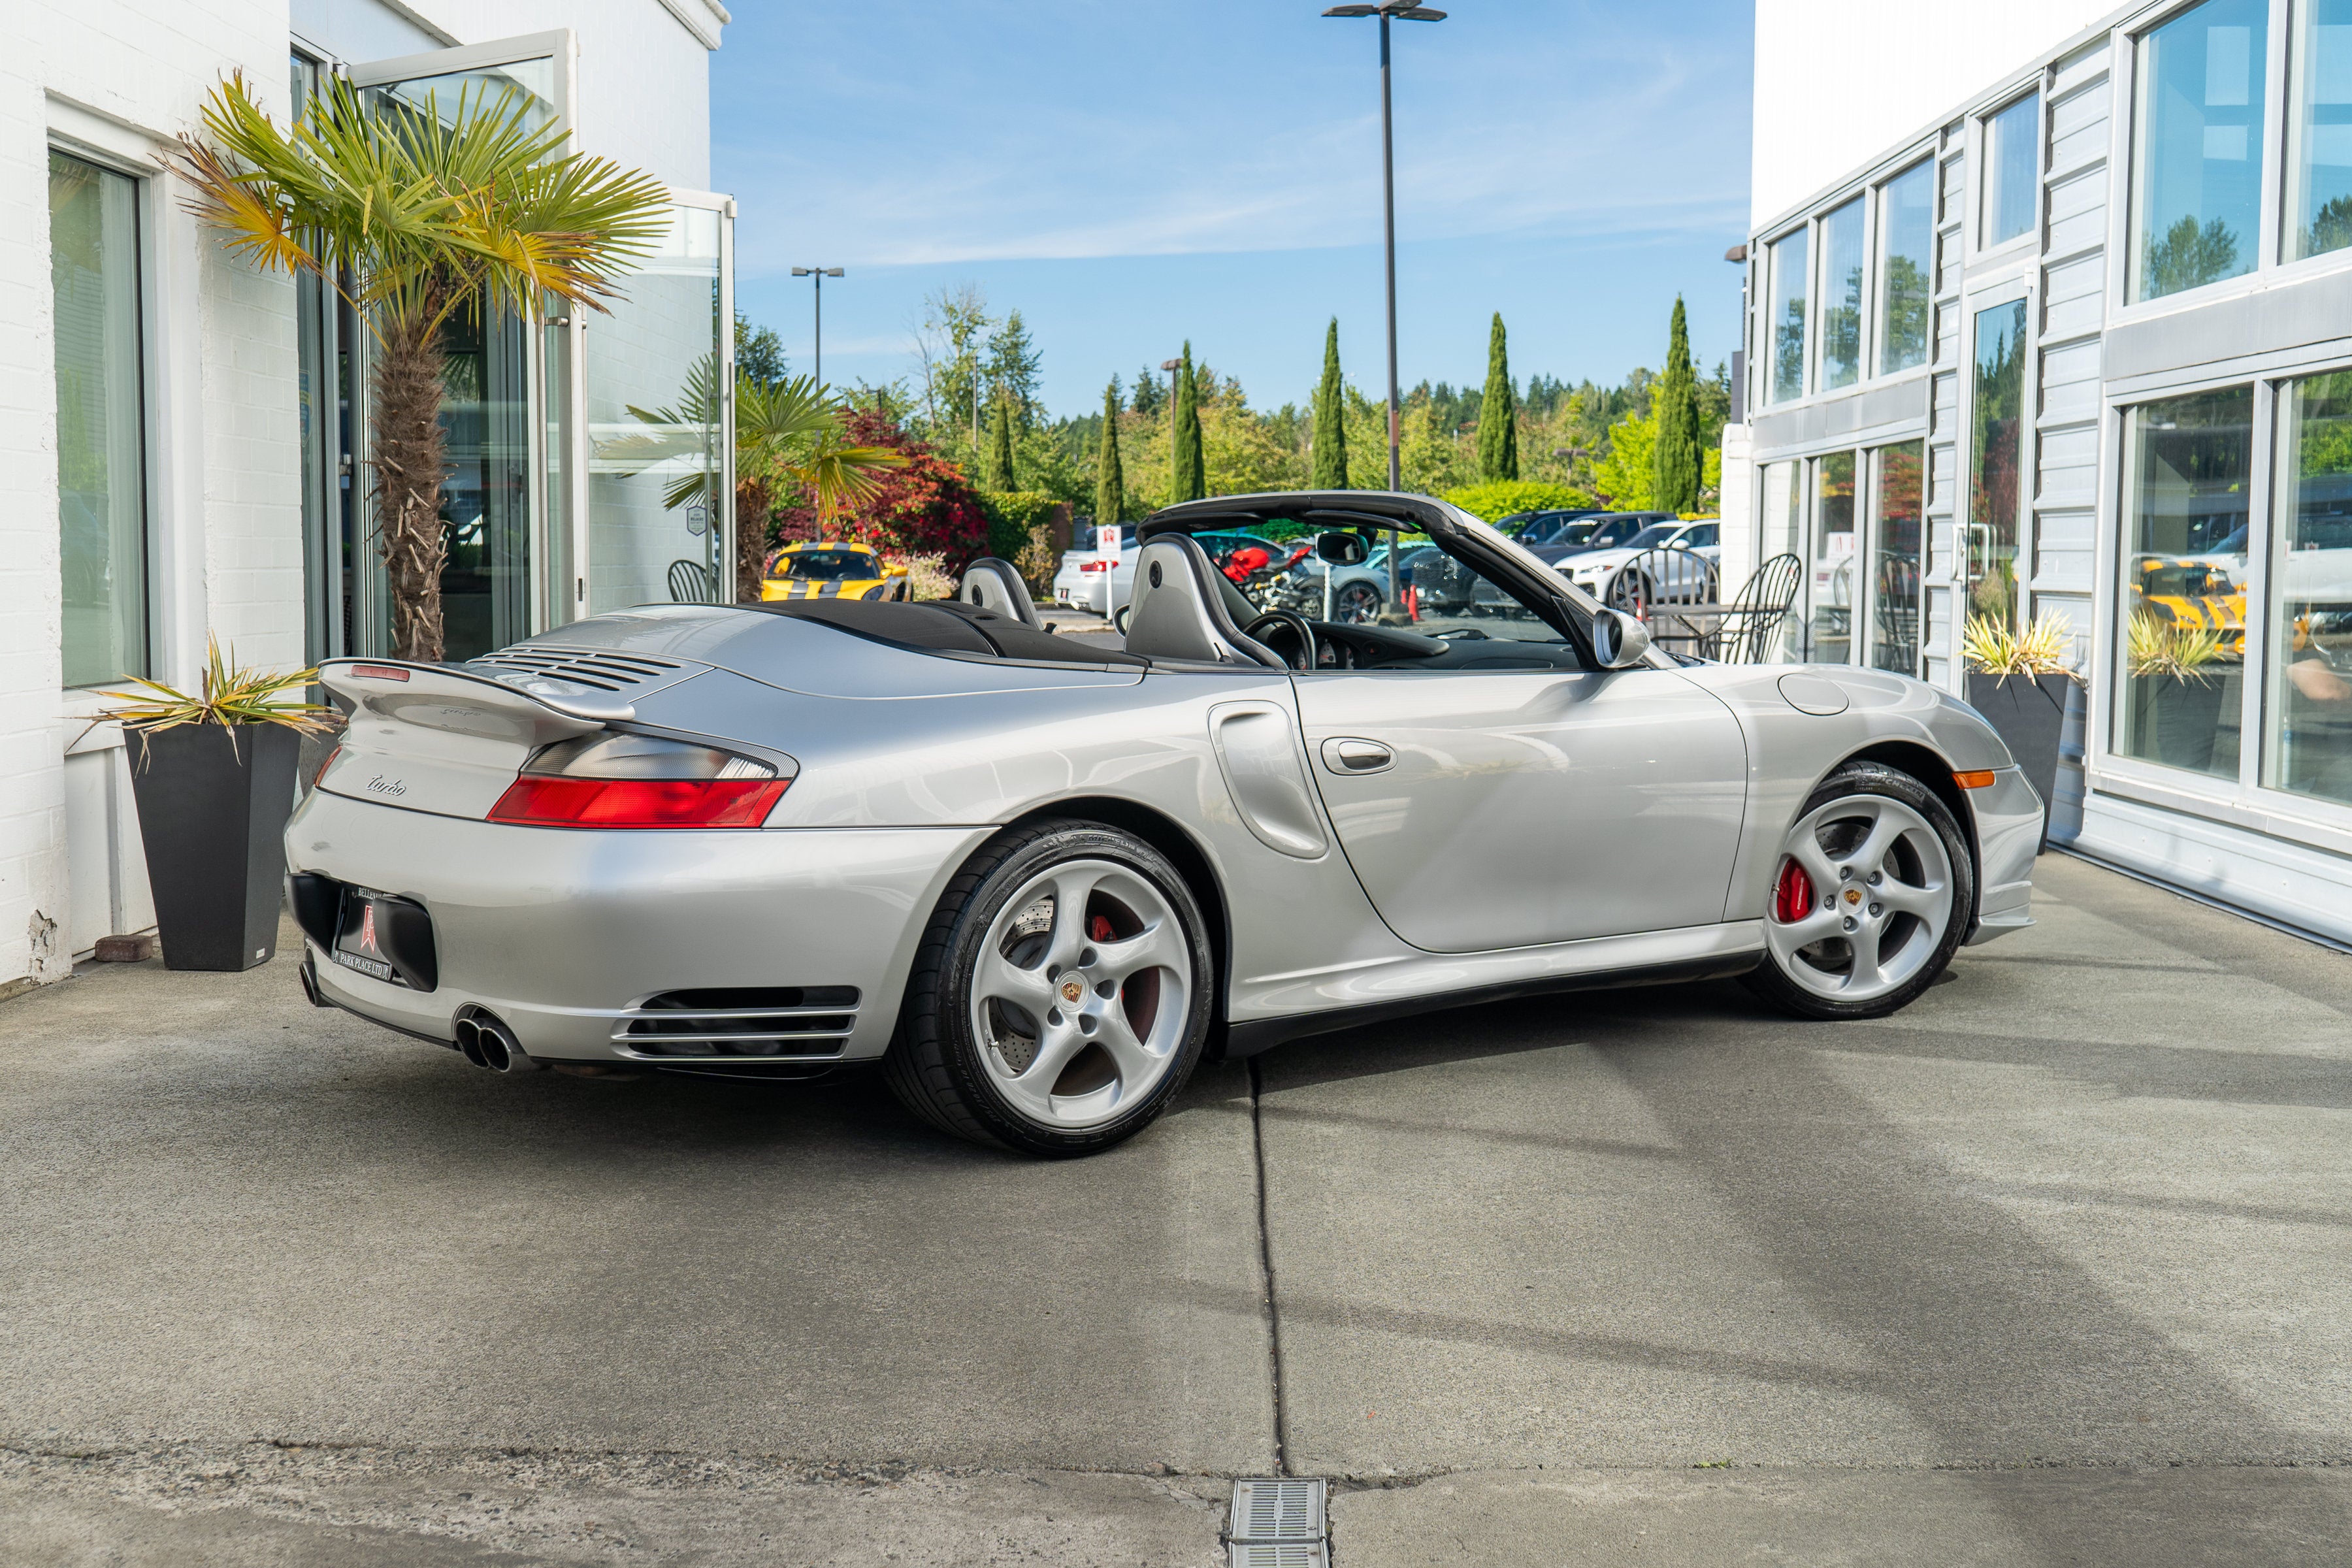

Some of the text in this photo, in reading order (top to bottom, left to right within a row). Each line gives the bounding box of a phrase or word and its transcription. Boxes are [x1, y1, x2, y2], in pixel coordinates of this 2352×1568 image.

[1087, 834, 1135, 850] MICHELIN
[340, 953, 383, 975] PARK PLACE LTD
